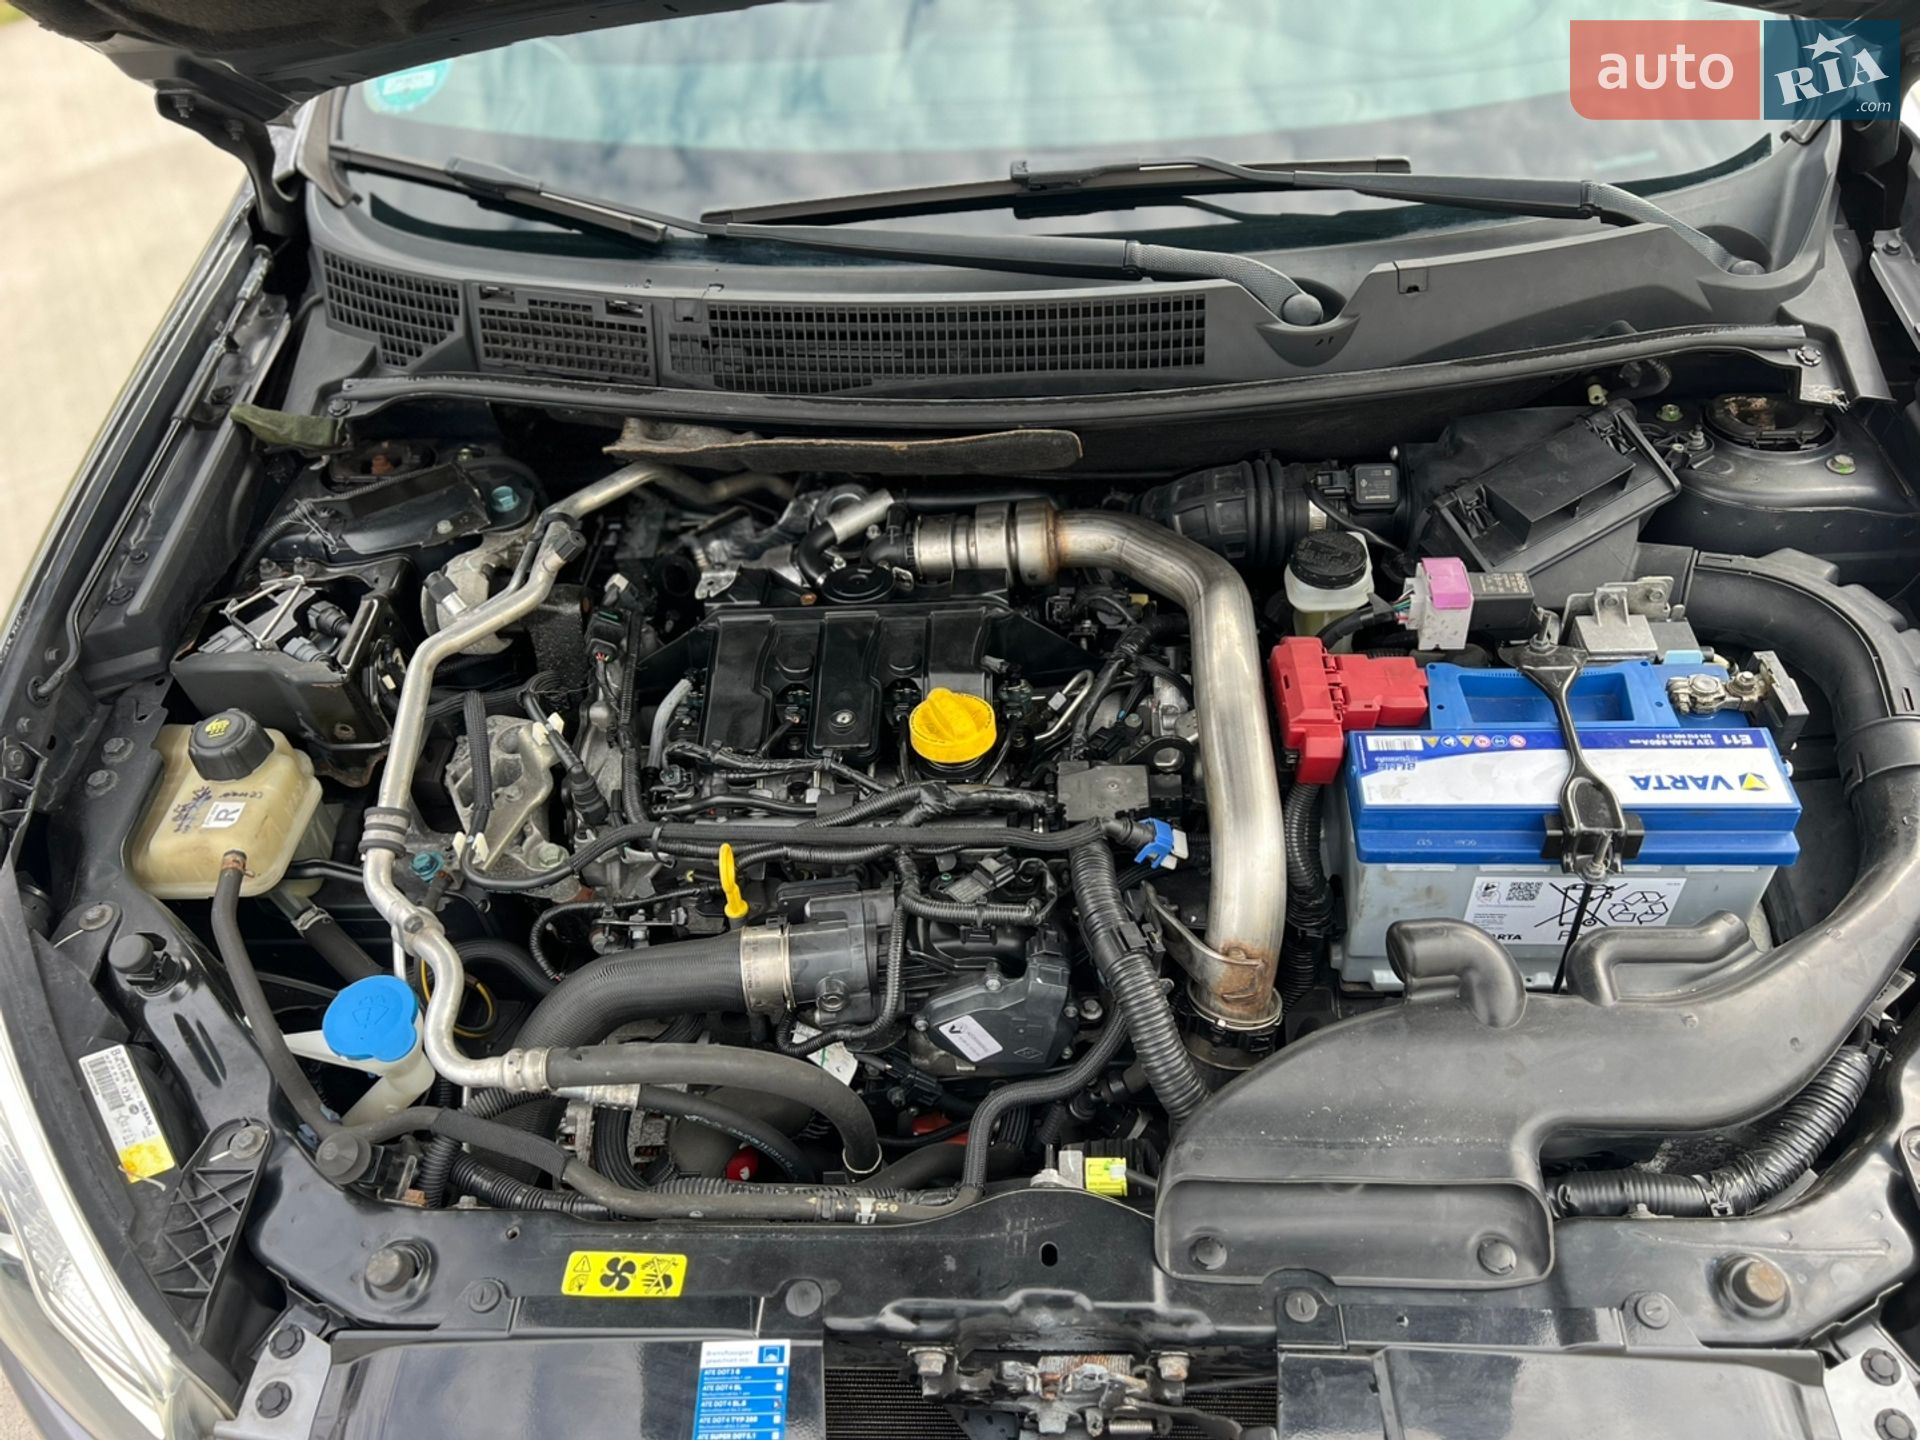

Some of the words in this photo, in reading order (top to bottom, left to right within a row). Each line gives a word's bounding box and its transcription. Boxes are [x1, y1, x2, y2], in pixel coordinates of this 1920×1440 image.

[1722, 734, 1753, 745] E11
[1629, 775, 1734, 791] VARTA
[214, 808, 240, 821] R
[713, 1416, 726, 1424] DOT
